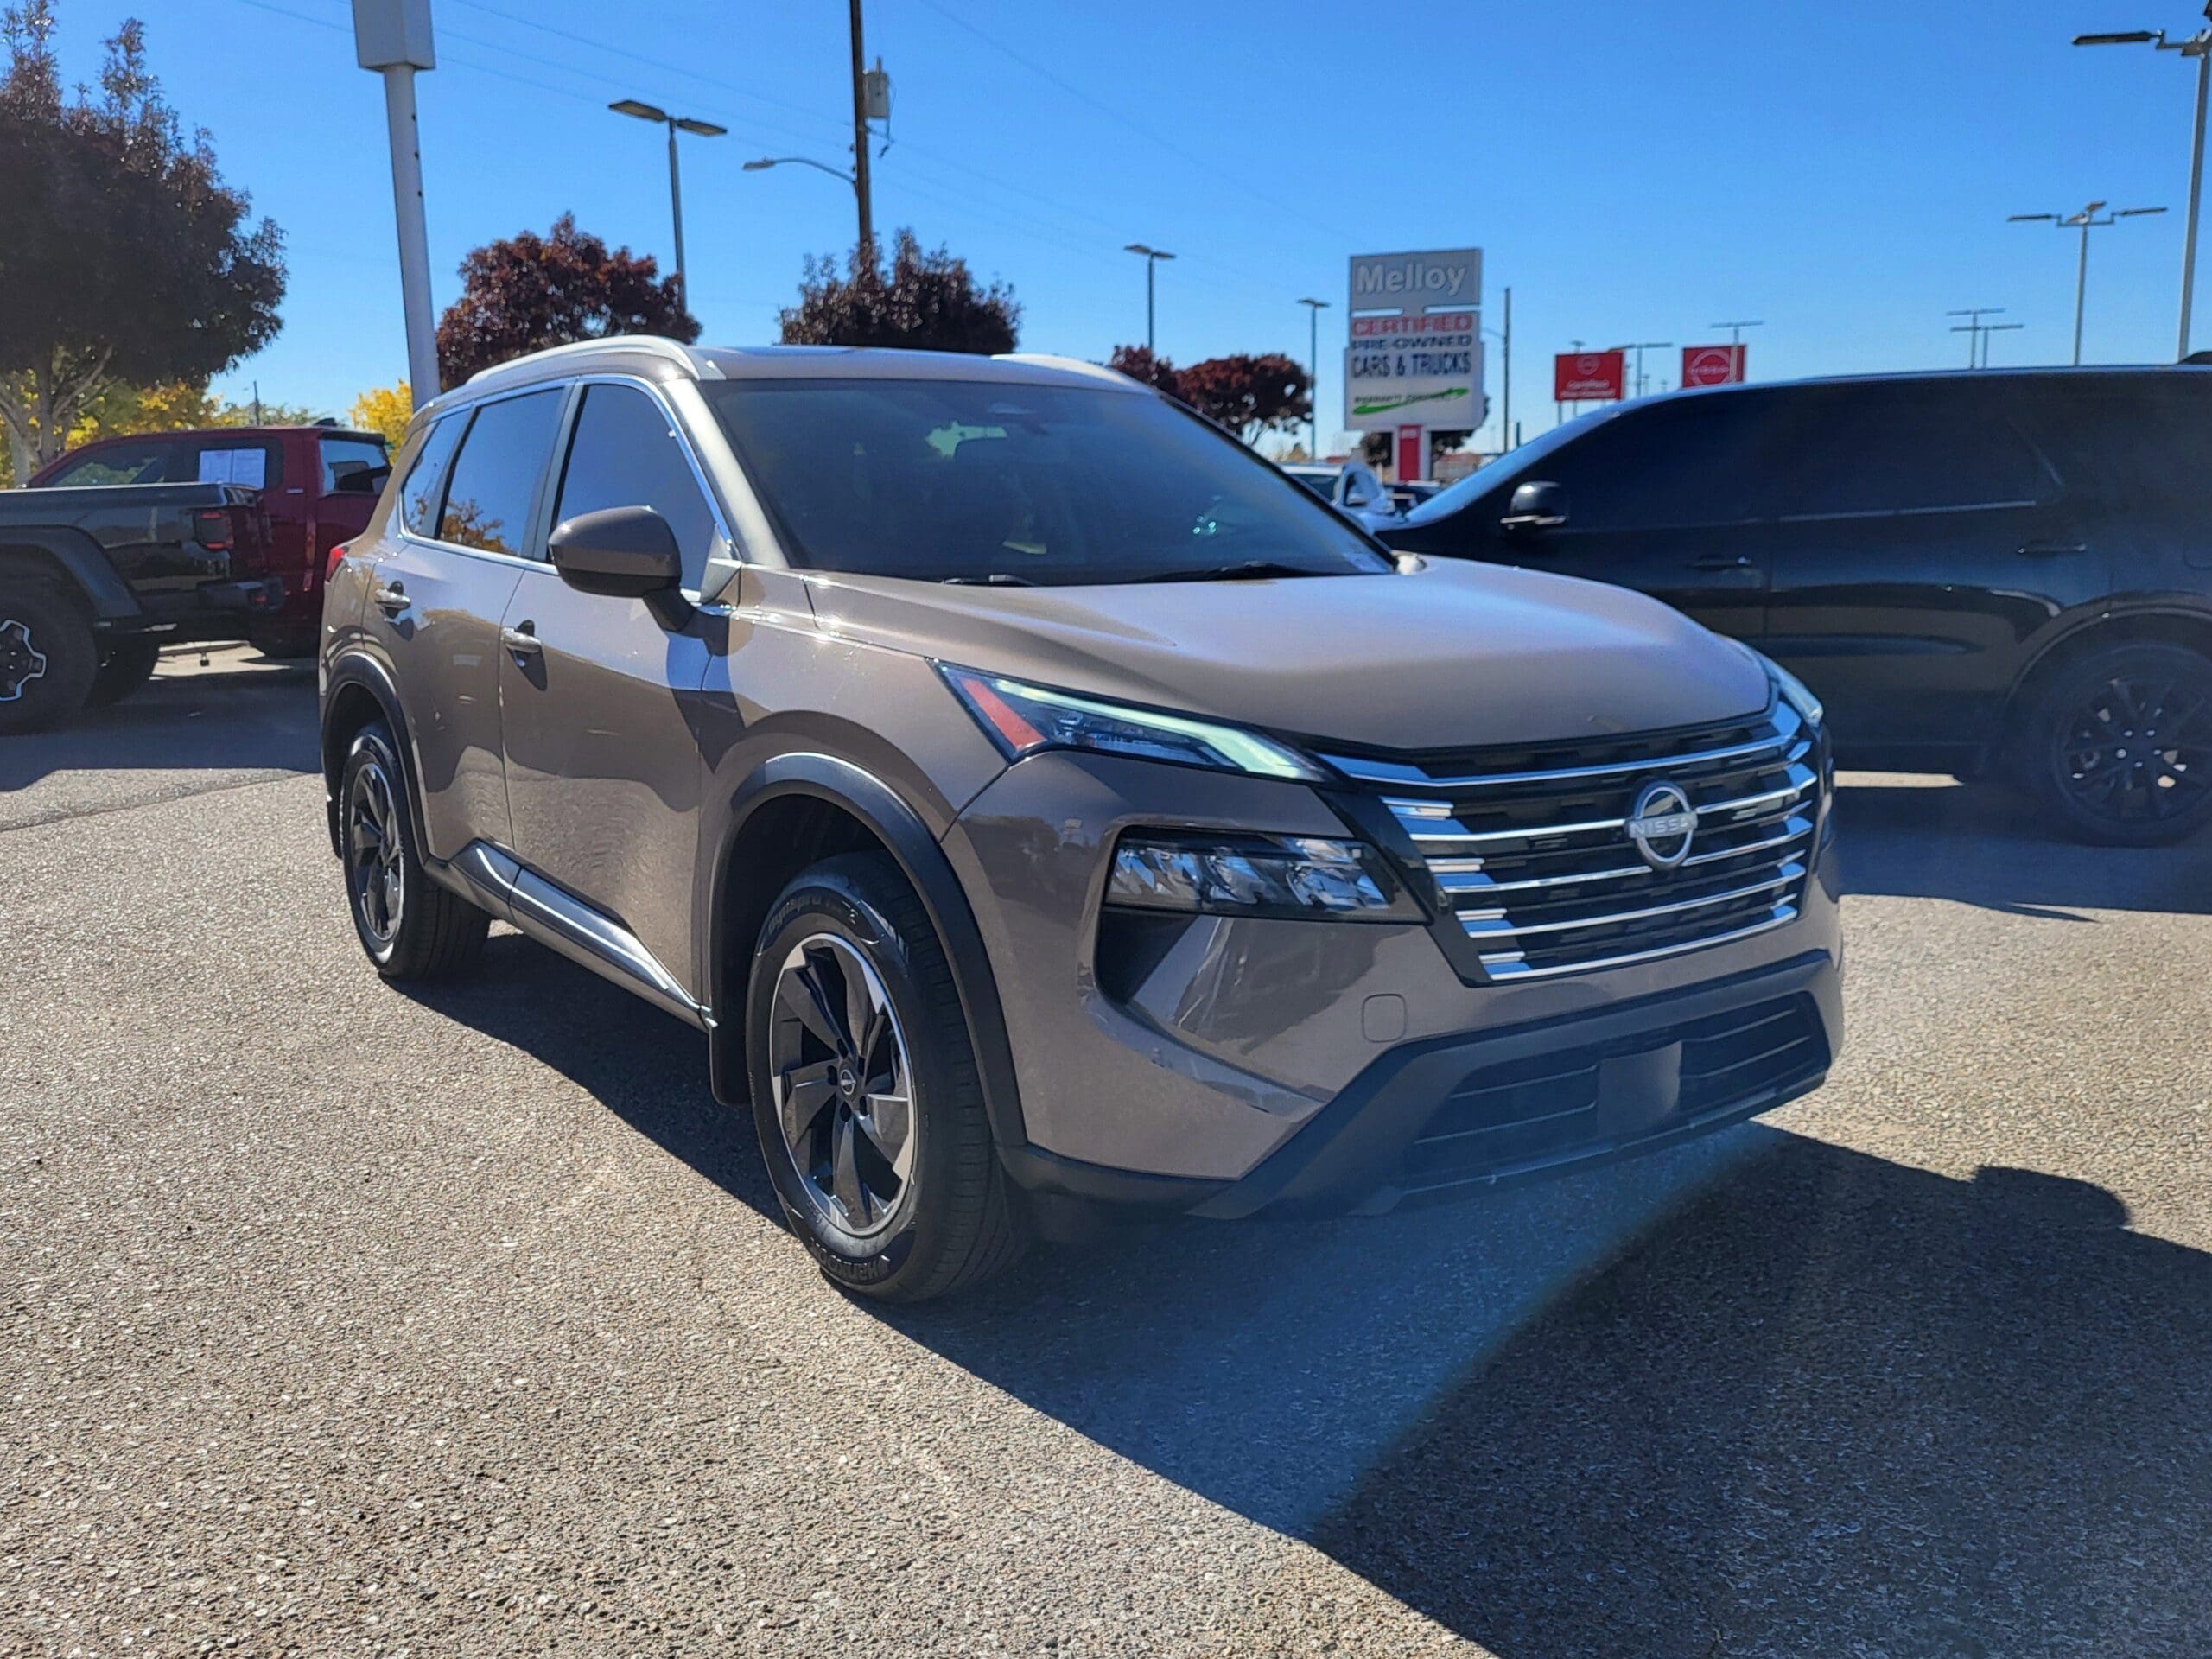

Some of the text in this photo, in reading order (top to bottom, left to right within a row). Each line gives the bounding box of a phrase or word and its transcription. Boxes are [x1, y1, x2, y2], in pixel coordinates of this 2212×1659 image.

[1356, 263, 1466, 296] Melloy
[1351, 314, 1473, 336] CERTIFIED
[1351, 352, 1472, 378] CARS & TRUCKS
[1630, 812, 1697, 837] NISSAN
